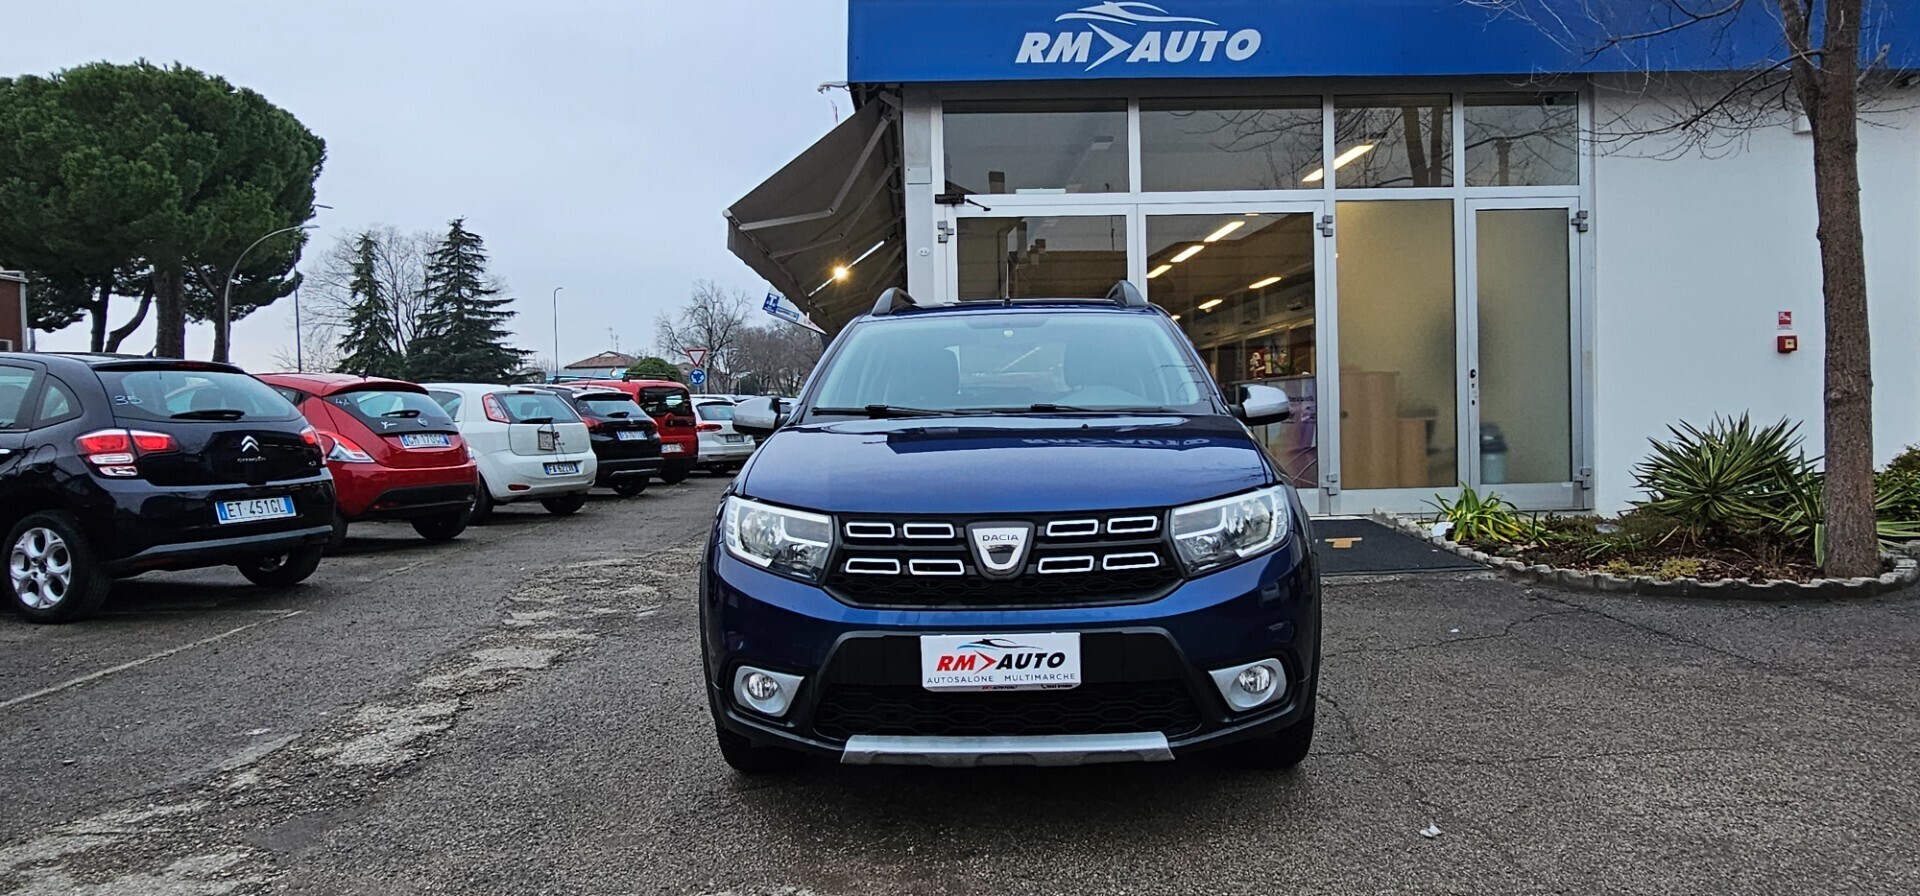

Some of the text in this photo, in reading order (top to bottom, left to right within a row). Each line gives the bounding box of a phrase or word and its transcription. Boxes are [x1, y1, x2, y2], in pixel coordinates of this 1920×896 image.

[1015, 29, 1262, 64] RM AUTO
[114, 395, 143, 406] 35
[226, 499, 286, 518] ET 451GL
[982, 534, 1020, 542] DACIA
[936, 652, 1066, 671] RM AUTO
[926, 672, 1076, 684] AUTOSALONE MULTIMARCHE
